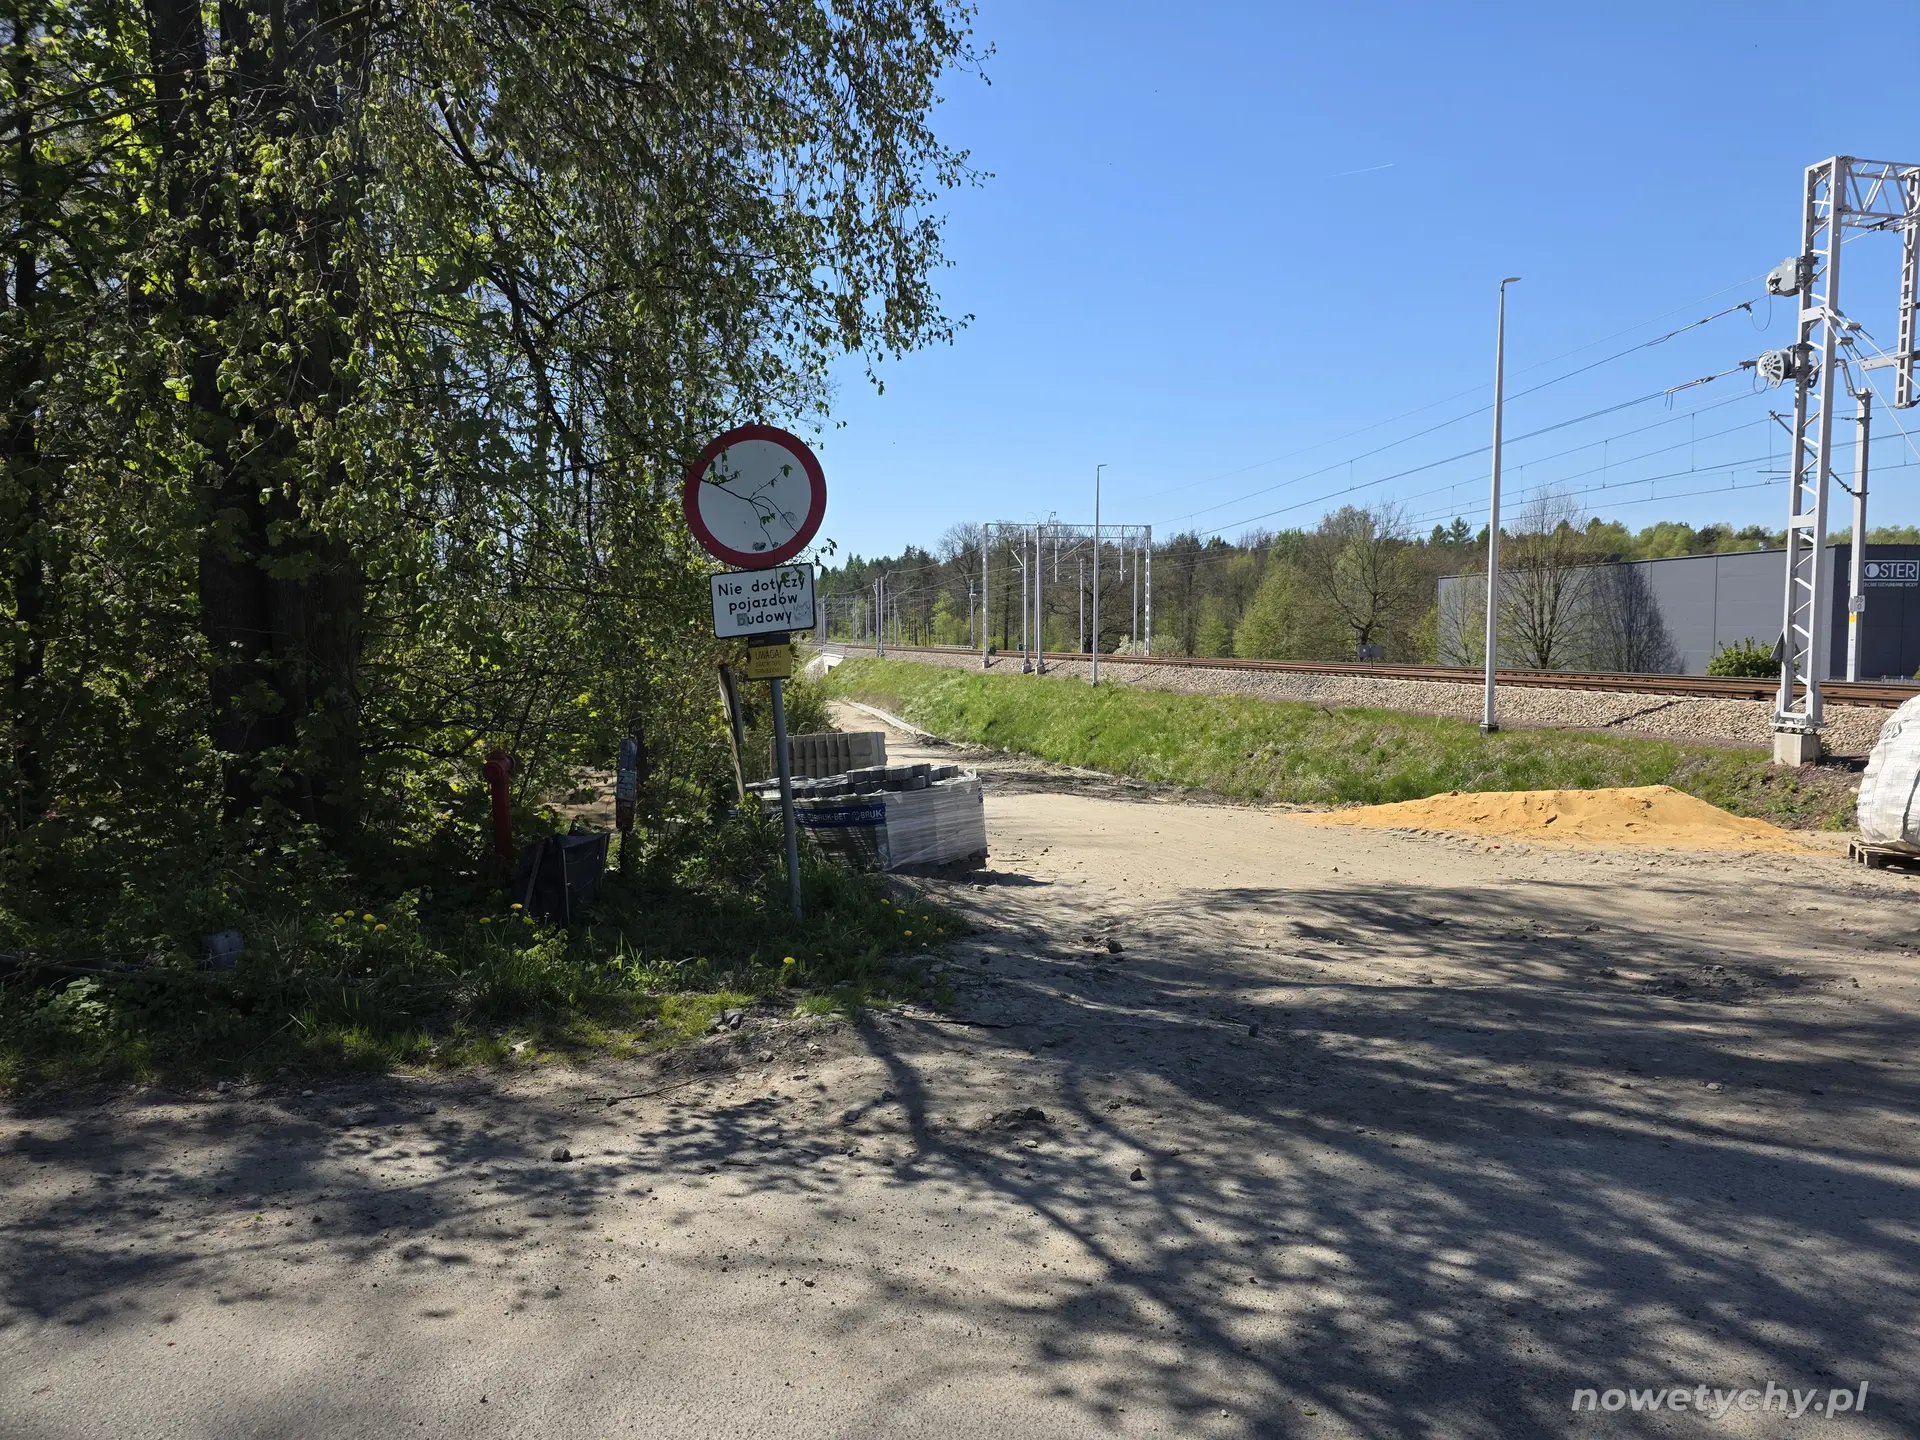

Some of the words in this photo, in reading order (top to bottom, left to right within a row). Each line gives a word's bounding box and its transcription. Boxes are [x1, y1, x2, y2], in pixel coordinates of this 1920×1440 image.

[1864, 563, 1916, 578] OSTER
[718, 582, 742, 596] Nie
[751, 577, 805, 593] dotyczy
[729, 592, 798, 615] pojazdów
[737, 611, 792, 626] budowy
[755, 649, 782, 660] UWAGA!
